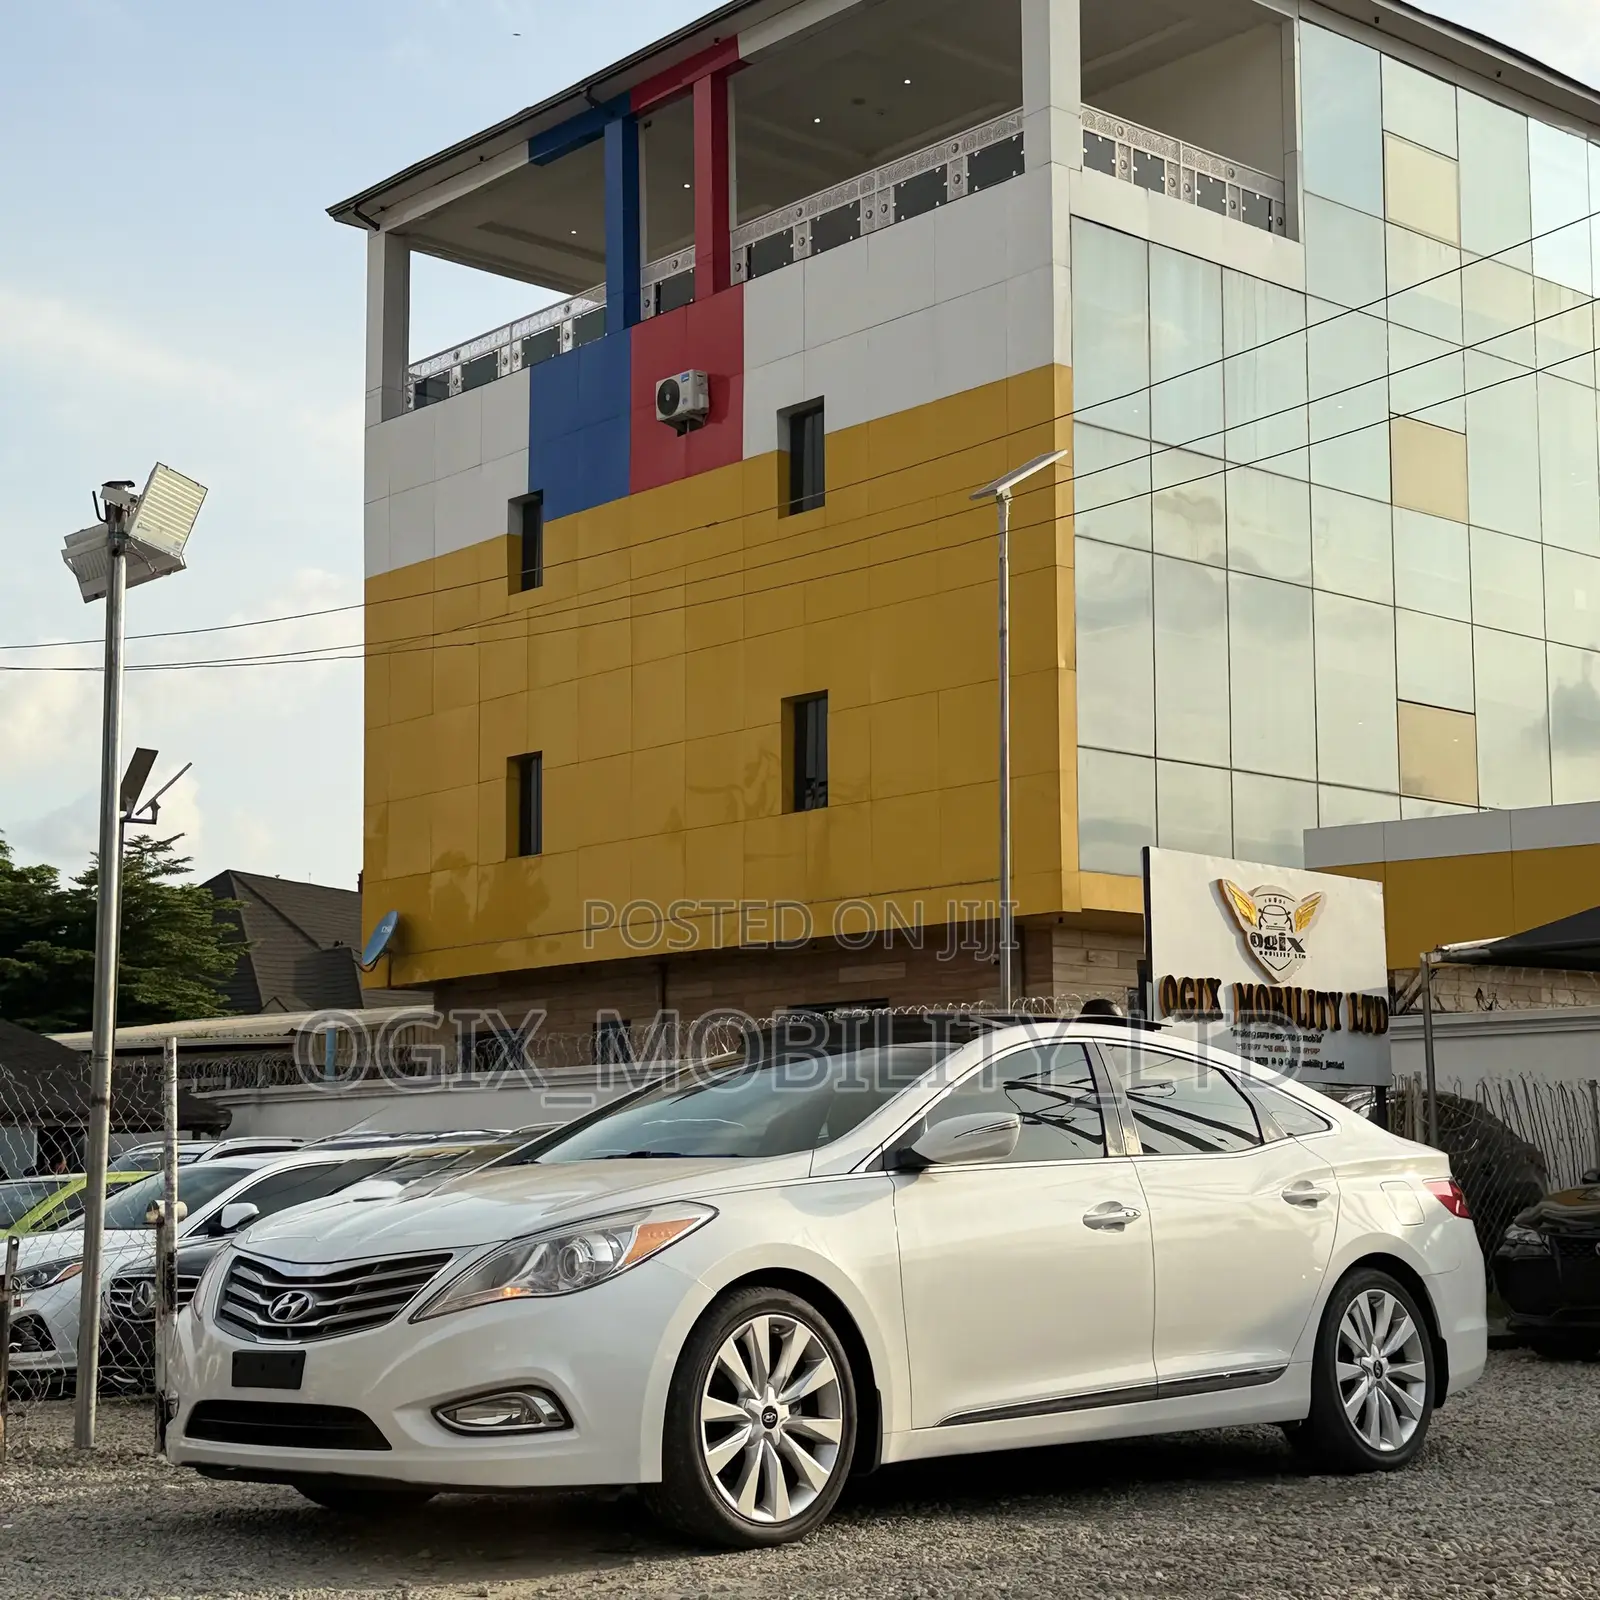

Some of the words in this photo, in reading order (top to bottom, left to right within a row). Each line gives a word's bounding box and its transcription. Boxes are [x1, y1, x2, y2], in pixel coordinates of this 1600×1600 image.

[1159, 974, 1224, 1021] OGIX
[1232, 982, 1343, 1032] MOBILITY
[1346, 992, 1389, 1034] LTD
